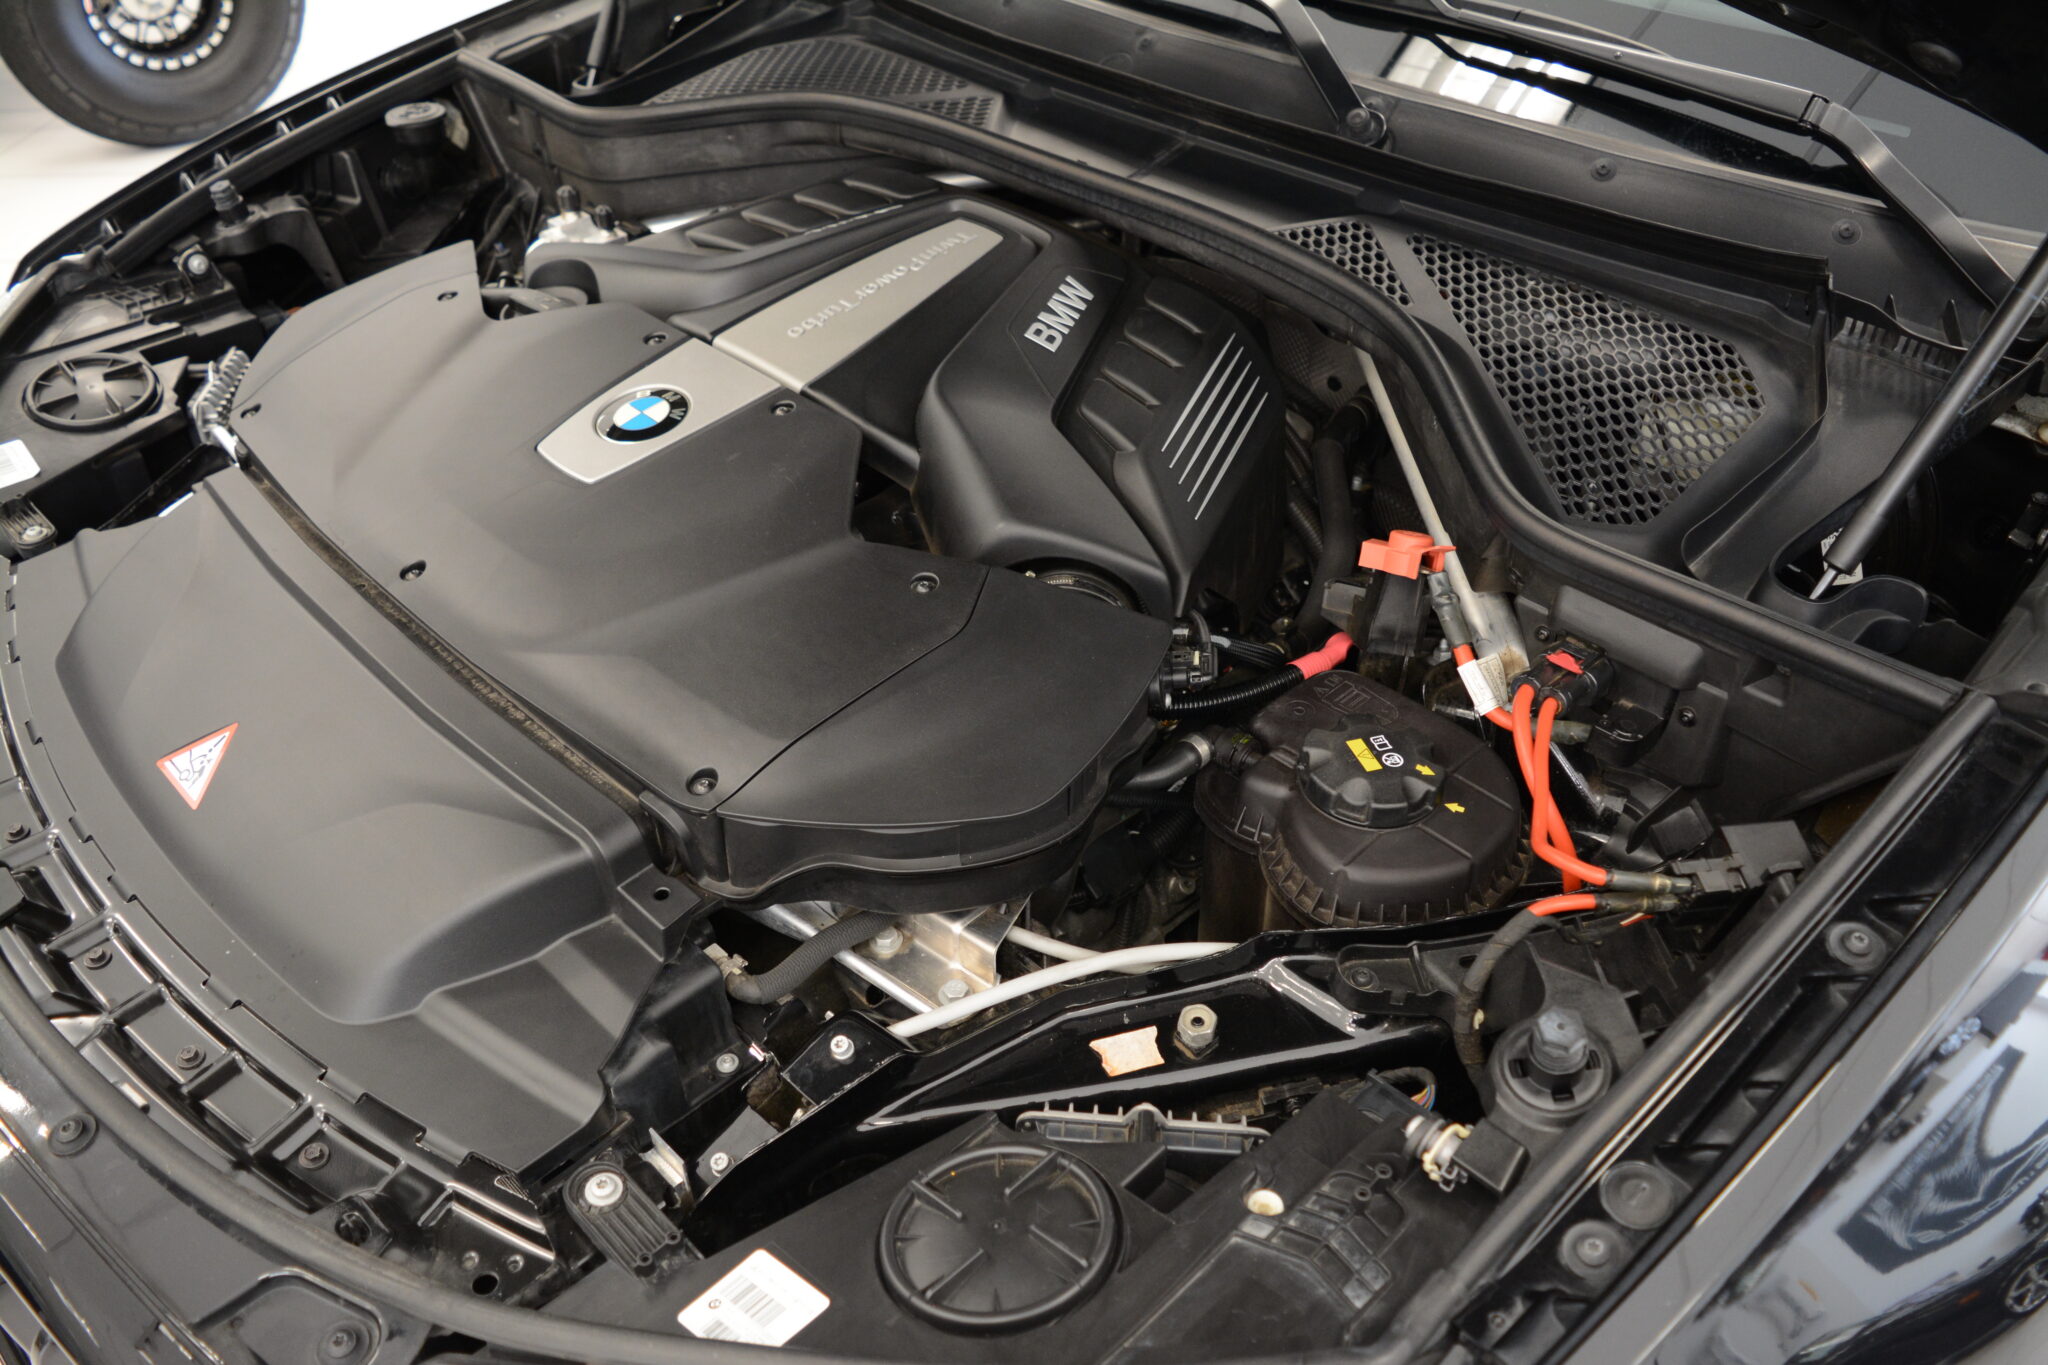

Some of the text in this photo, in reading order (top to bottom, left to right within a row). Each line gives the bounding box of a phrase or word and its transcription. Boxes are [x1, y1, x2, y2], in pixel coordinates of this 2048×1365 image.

[787, 231, 978, 338] TwinPower Turbo
[1024, 275, 1094, 352] BMW
